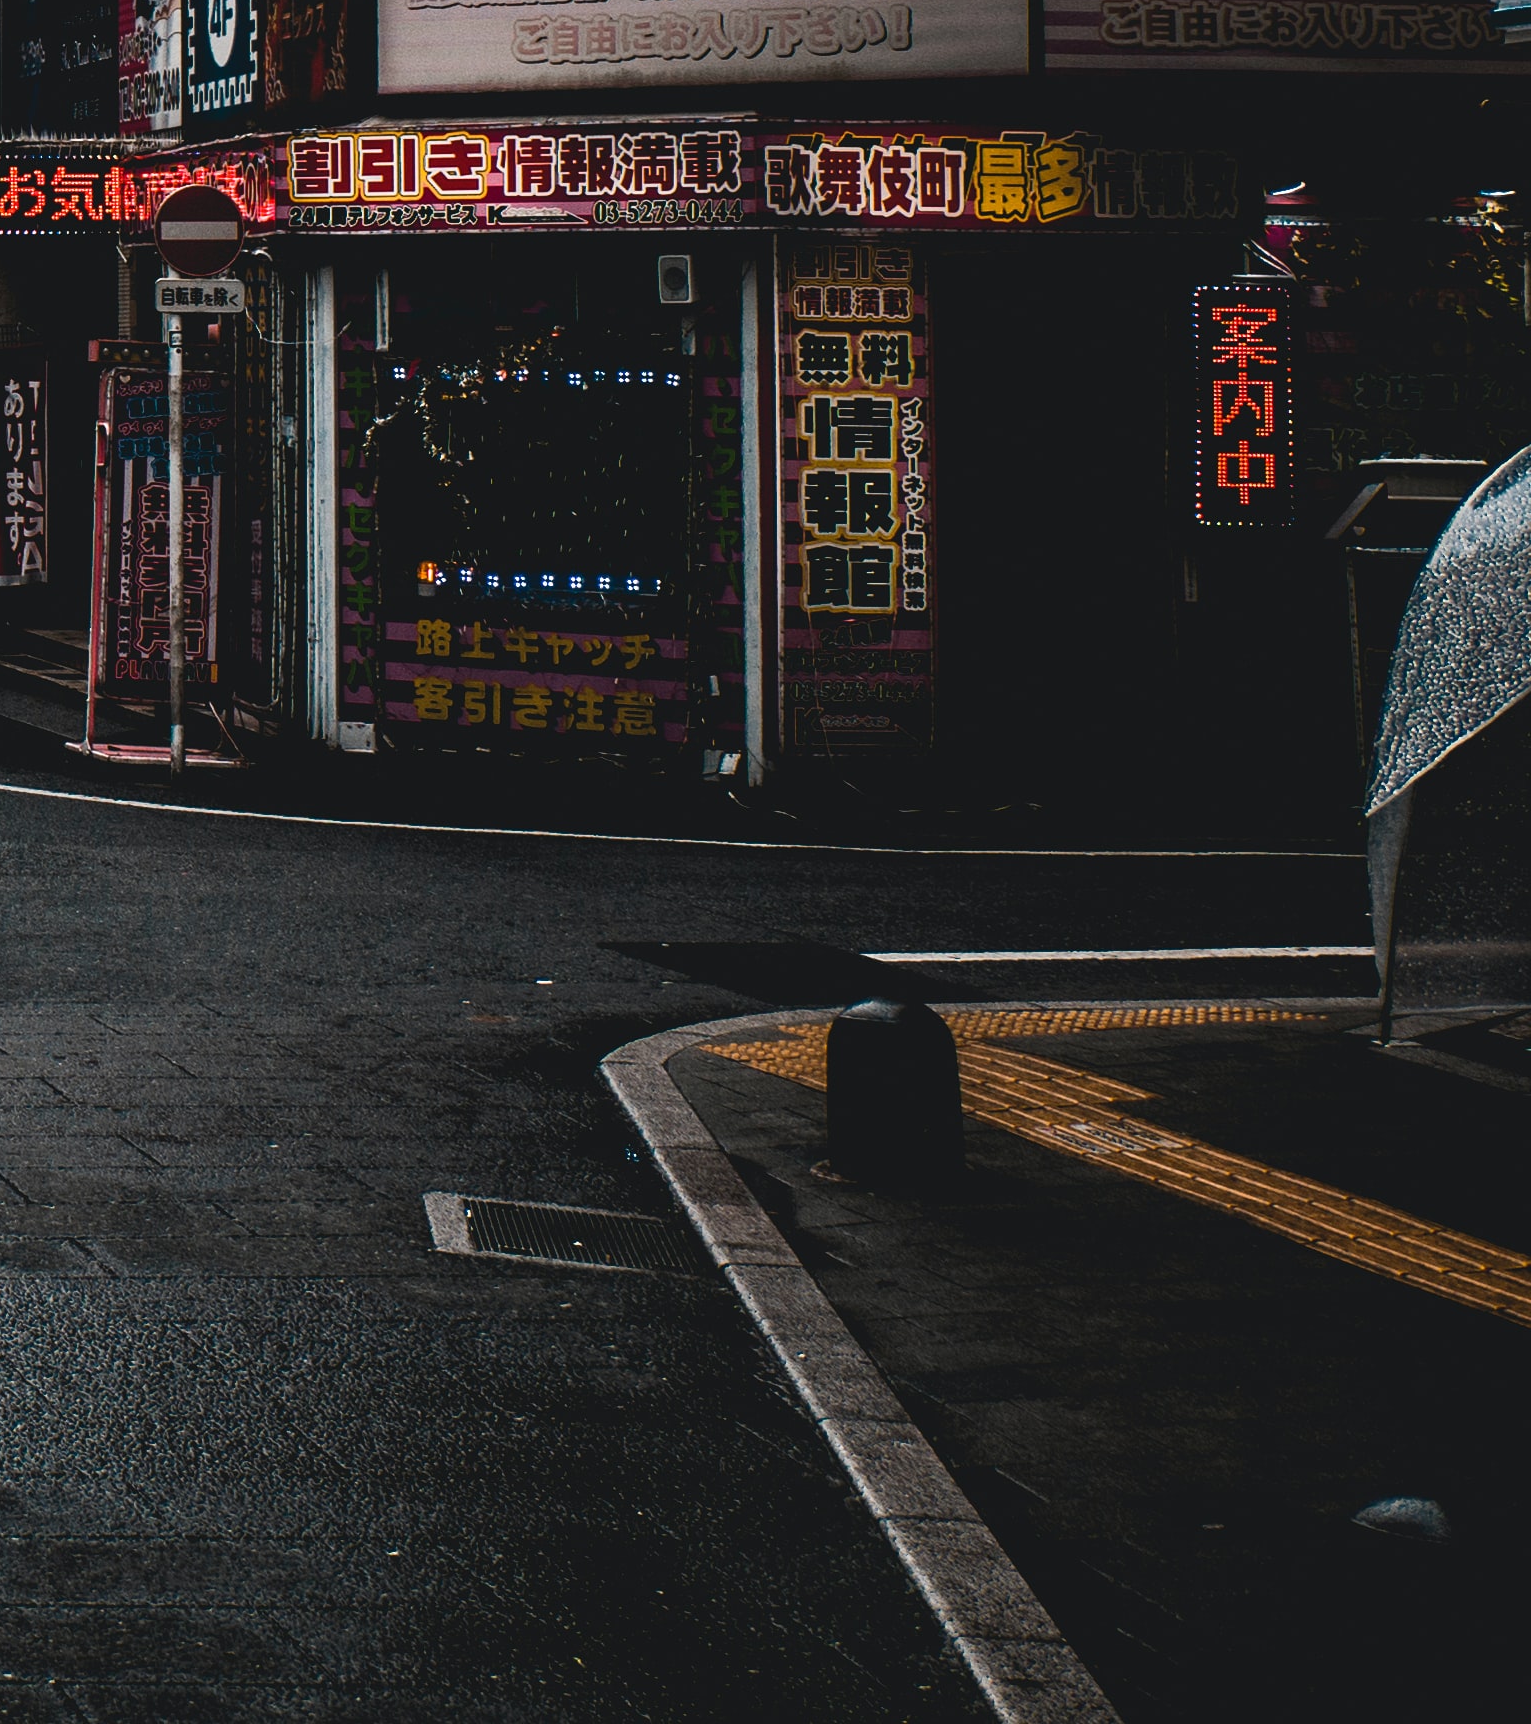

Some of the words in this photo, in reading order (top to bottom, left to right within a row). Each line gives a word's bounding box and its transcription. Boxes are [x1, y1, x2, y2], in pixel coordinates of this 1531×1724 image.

[593, 199, 744, 224] 03-5273-0444
[791, 243, 913, 284] 割引き
[161, 285, 239, 308] 自転車を除く
[793, 284, 915, 324] 情報満載
[796, 328, 916, 391] 無料
[1210, 303, 1280, 507] 案内中
[414, 617, 659, 675] 路上キャッチ
[412, 674, 658, 738] 客引き注意
